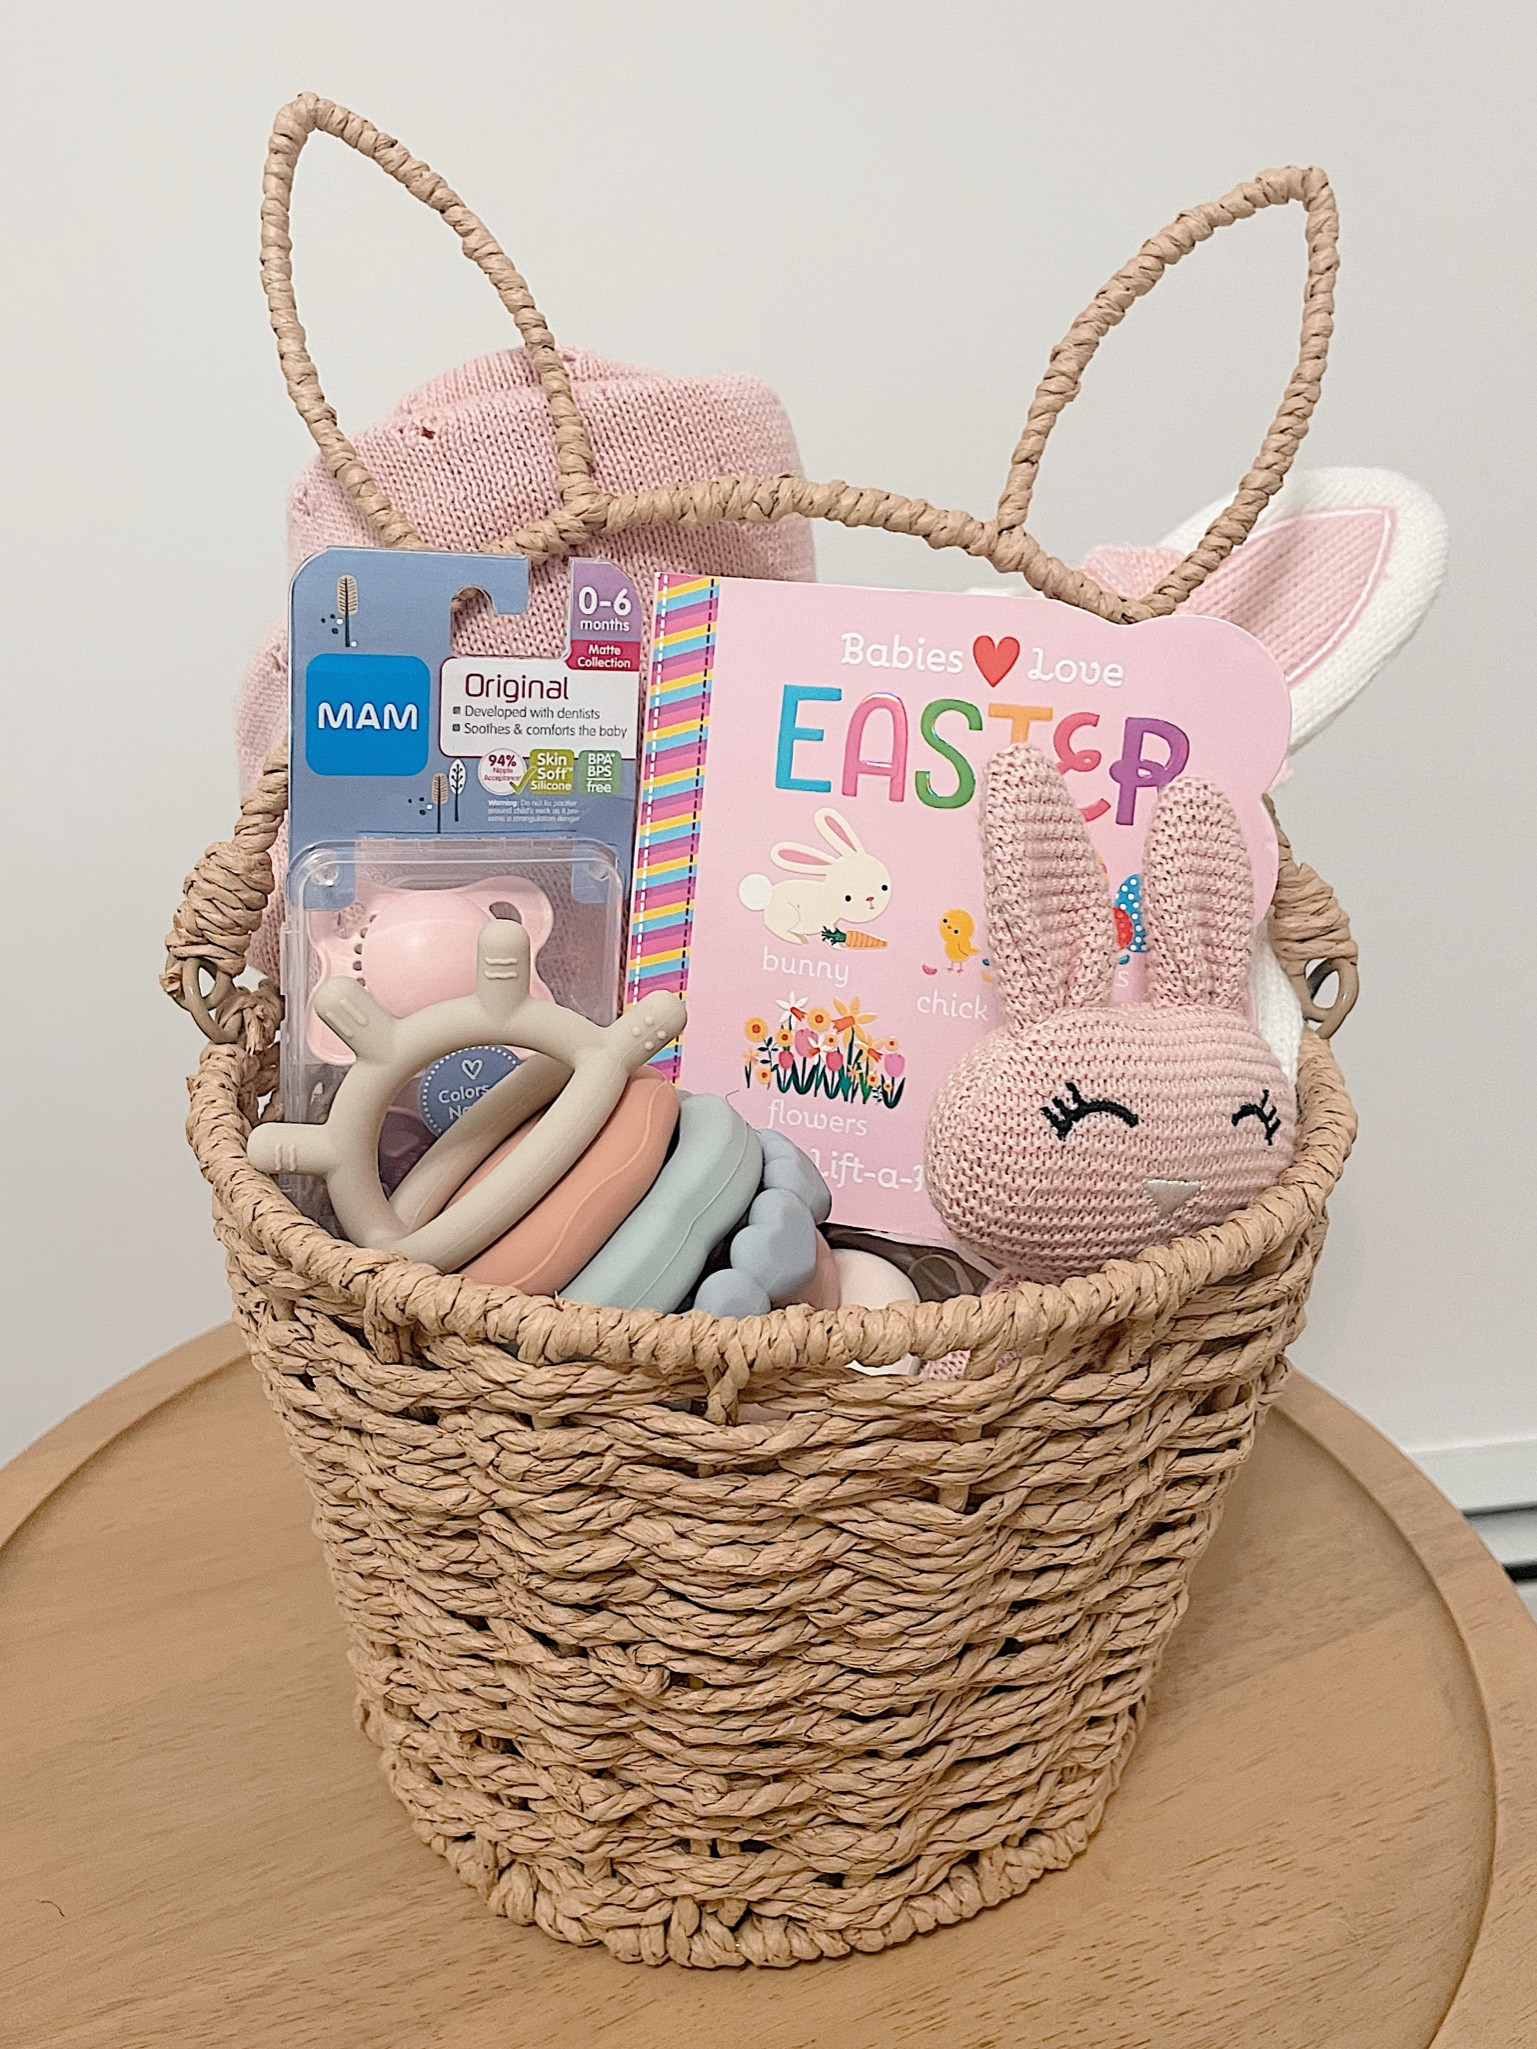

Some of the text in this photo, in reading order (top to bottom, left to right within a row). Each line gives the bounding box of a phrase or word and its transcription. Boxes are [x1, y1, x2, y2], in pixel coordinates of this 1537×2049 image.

[578, 586, 632, 616] 0-6
[580, 617, 630, 632] months
[588, 644, 622, 656] Matte
[577, 656, 631, 669] Collection
[840, 632, 1125, 687] Babies Love
[465, 673, 569, 703] Original
[318, 701, 420, 731] MAM
[465, 705, 601, 720] Developed with dentists
[464, 723, 628, 739] Soothes & comforts the baby
[488, 754, 517, 767] 94%
[537, 752, 567, 766] Skin
[587, 765, 612, 778] BPS
[530, 780, 573, 791] Silicone
[586, 782, 612, 793] free
[762, 946, 850, 987] bunny
[917, 989, 989, 1021] chick
[768, 1099, 868, 1136] flowers
